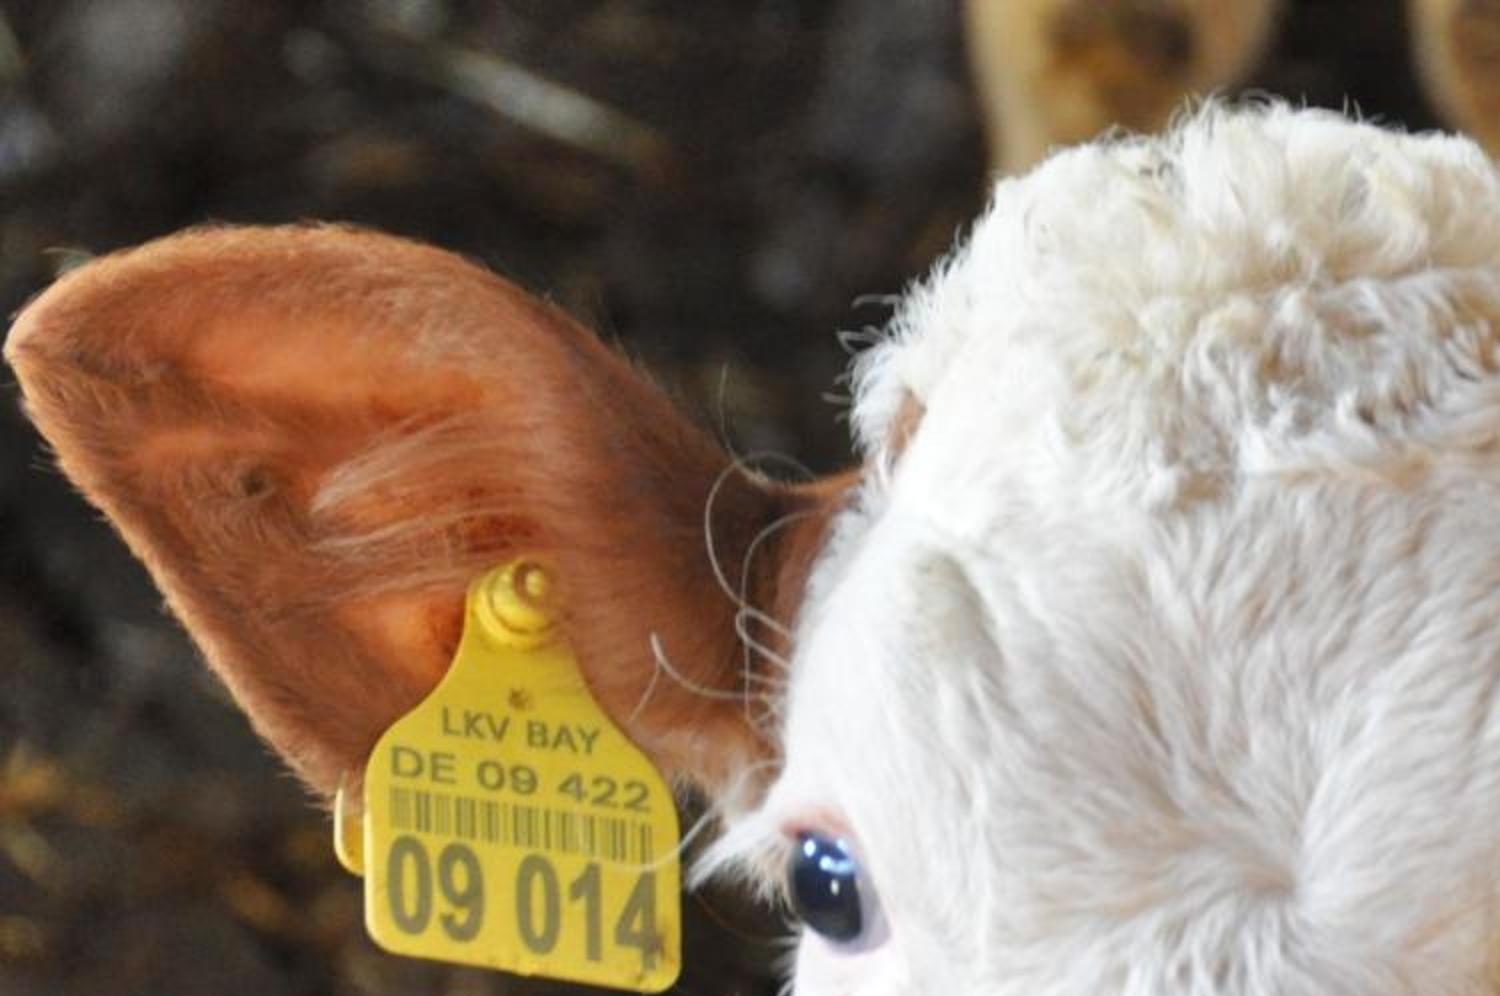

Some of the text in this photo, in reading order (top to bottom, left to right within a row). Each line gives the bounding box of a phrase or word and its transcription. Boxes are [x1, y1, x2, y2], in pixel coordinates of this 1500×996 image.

[442, 707, 599, 755] LKV BAY
[392, 745, 651, 811] DE 09 422
[387, 835, 662, 971] 09 014
